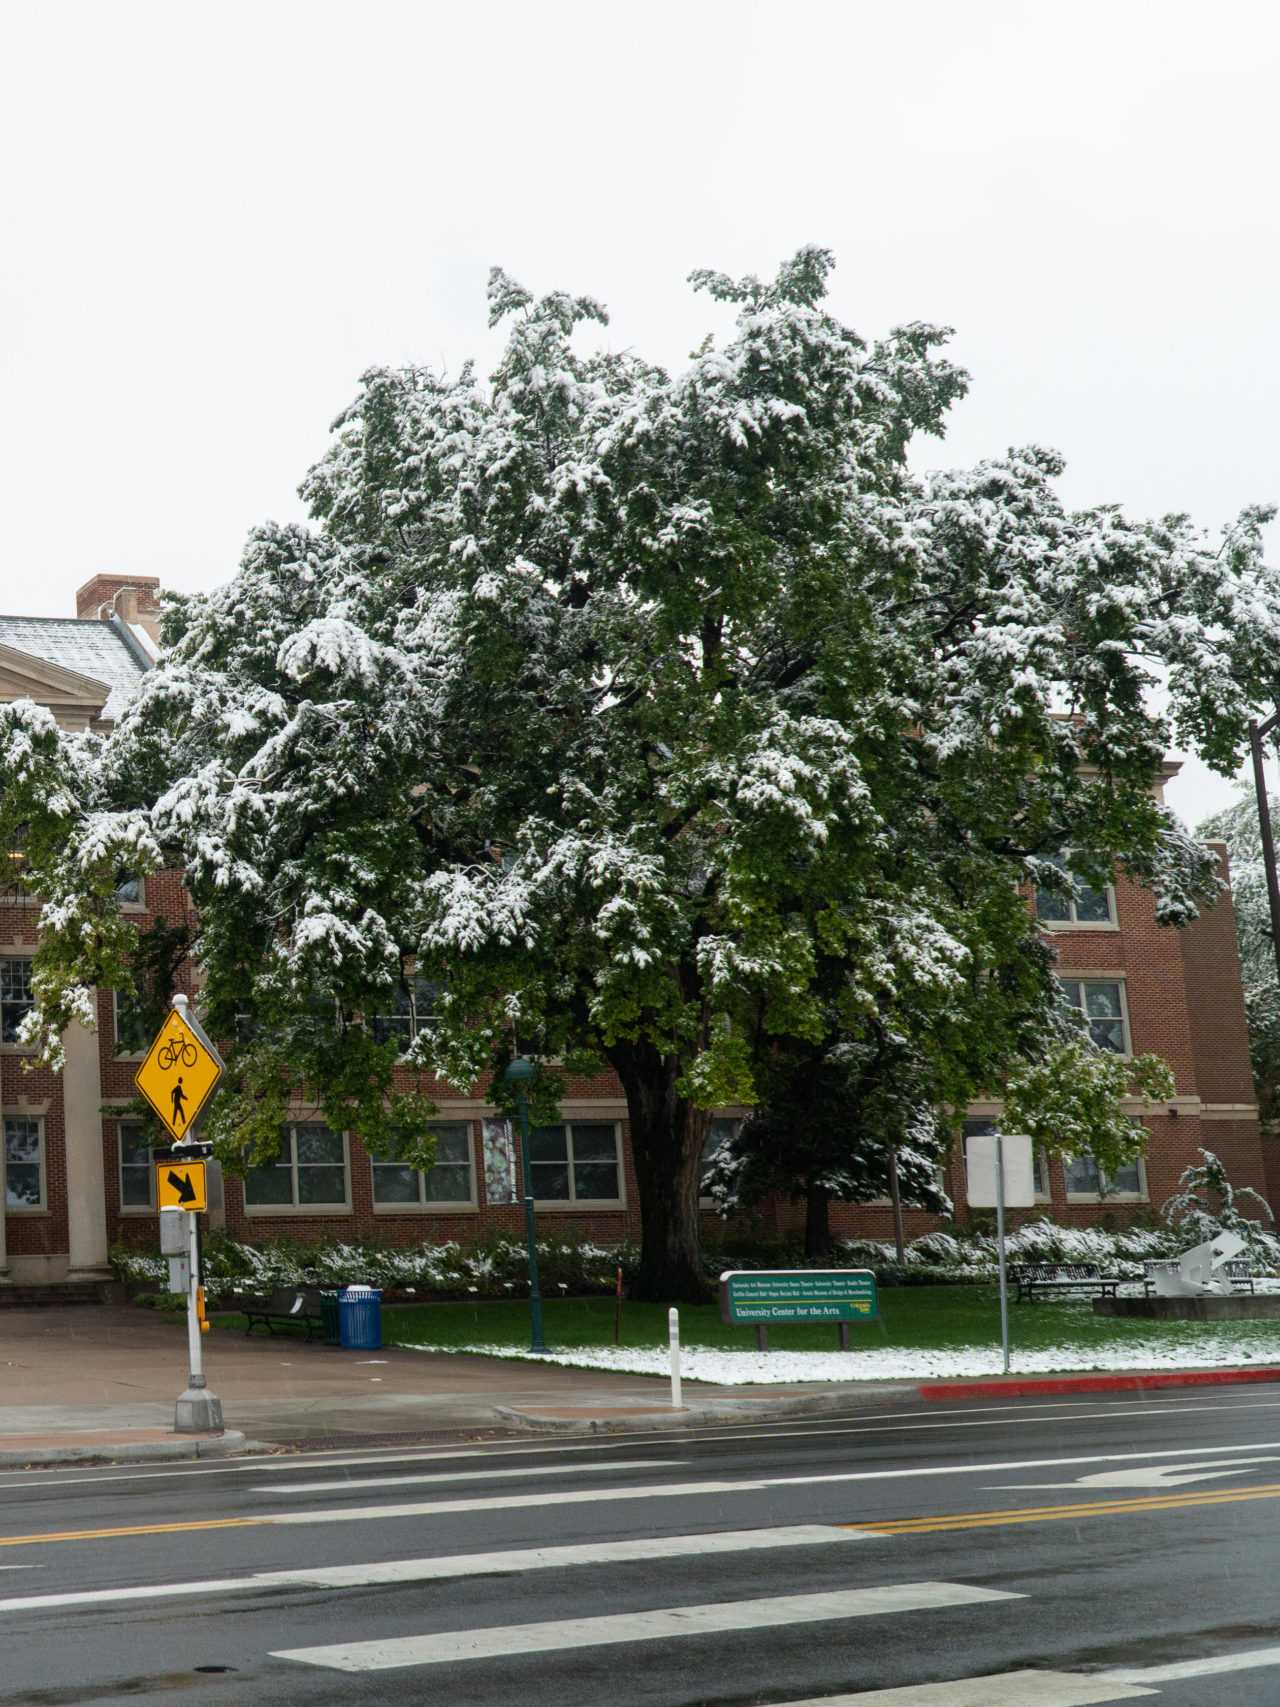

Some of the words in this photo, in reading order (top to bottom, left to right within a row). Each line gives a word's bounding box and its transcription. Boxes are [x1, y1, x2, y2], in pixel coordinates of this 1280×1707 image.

[736, 1307, 770, 1317] University
[771, 1306, 795, 1316] Center
[797, 1306, 808, 1315] for
[810, 1306, 823, 1315] the
[823, 1306, 840, 1315] Arts
